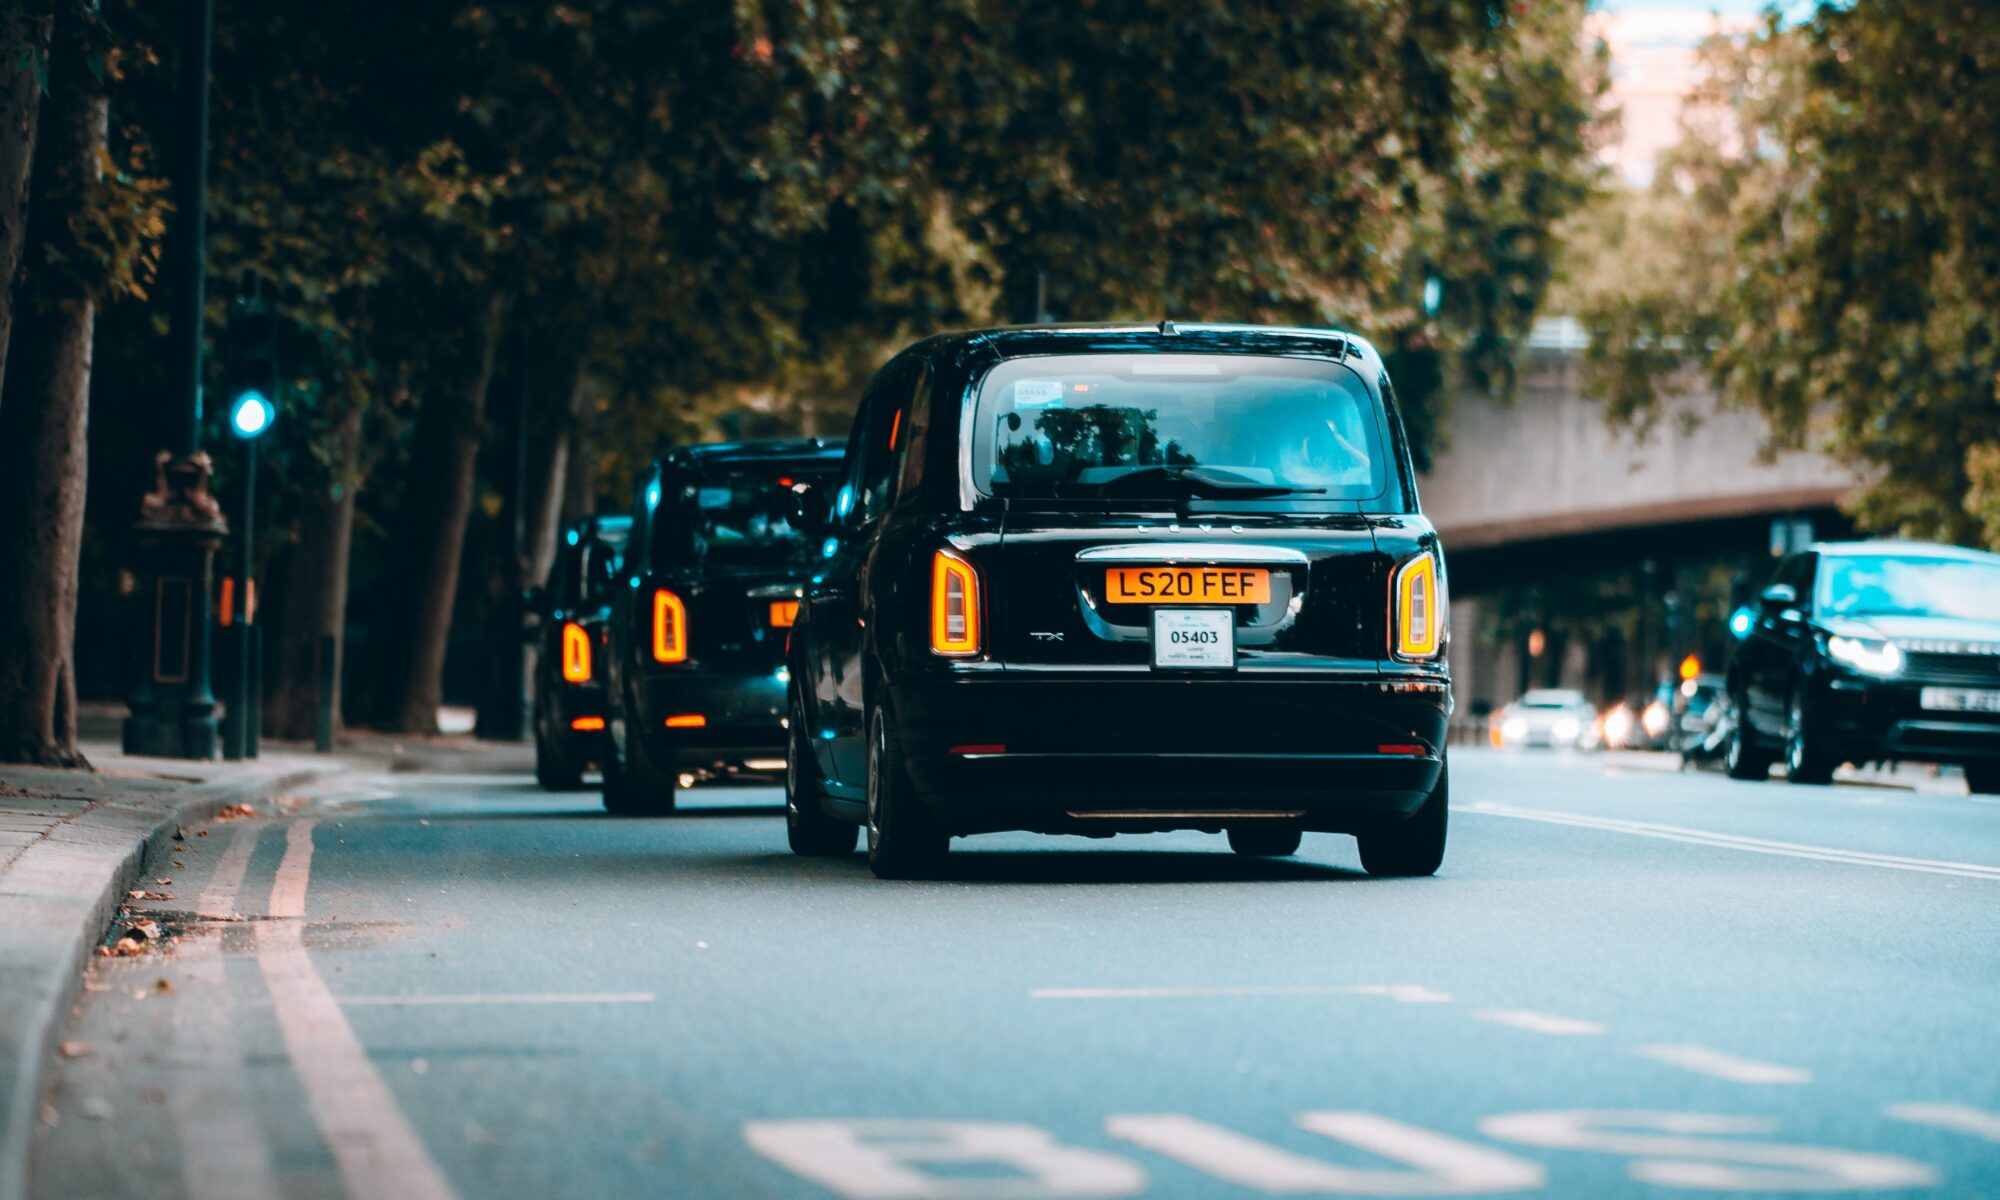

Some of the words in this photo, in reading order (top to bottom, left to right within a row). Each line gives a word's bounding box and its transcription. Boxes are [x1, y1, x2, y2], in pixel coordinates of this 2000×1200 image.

[1119, 572, 1193, 597] LS20
[1202, 572, 1256, 597] FEF
[1170, 631, 1219, 644] 05403
[743, 1110, 1940, 1199] BUS
